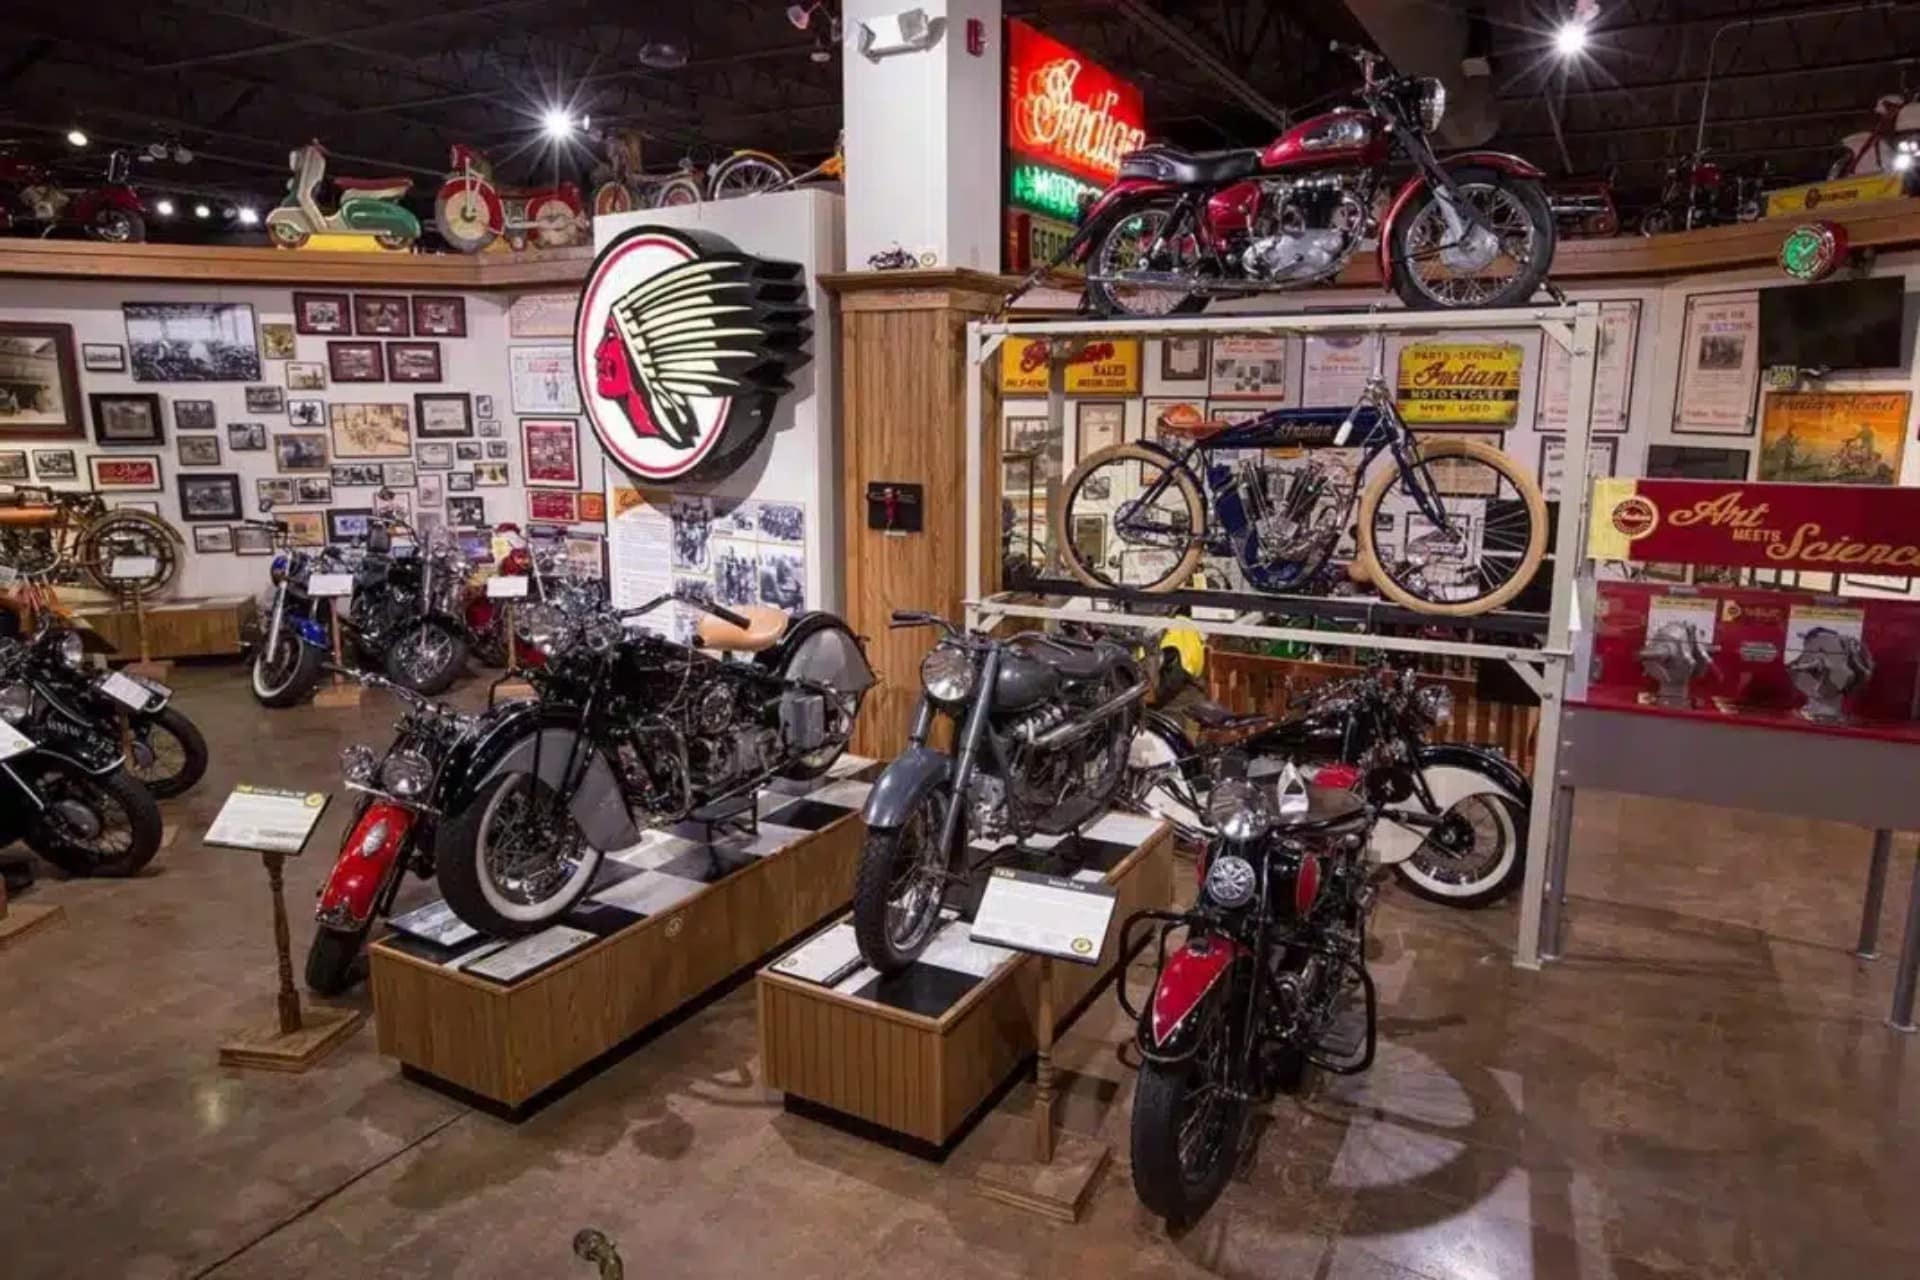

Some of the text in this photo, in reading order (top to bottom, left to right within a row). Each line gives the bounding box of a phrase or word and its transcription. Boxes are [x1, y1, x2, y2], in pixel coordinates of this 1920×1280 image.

[1413, 360, 1508, 387] Indian
[1410, 390, 1505, 400] MOTOCYCLES
[1459, 404, 1490, 412] USED
[1668, 491, 1769, 526] Art
[1732, 527, 1783, 542] MEETS
[1765, 523, 1920, 566] Scienc
